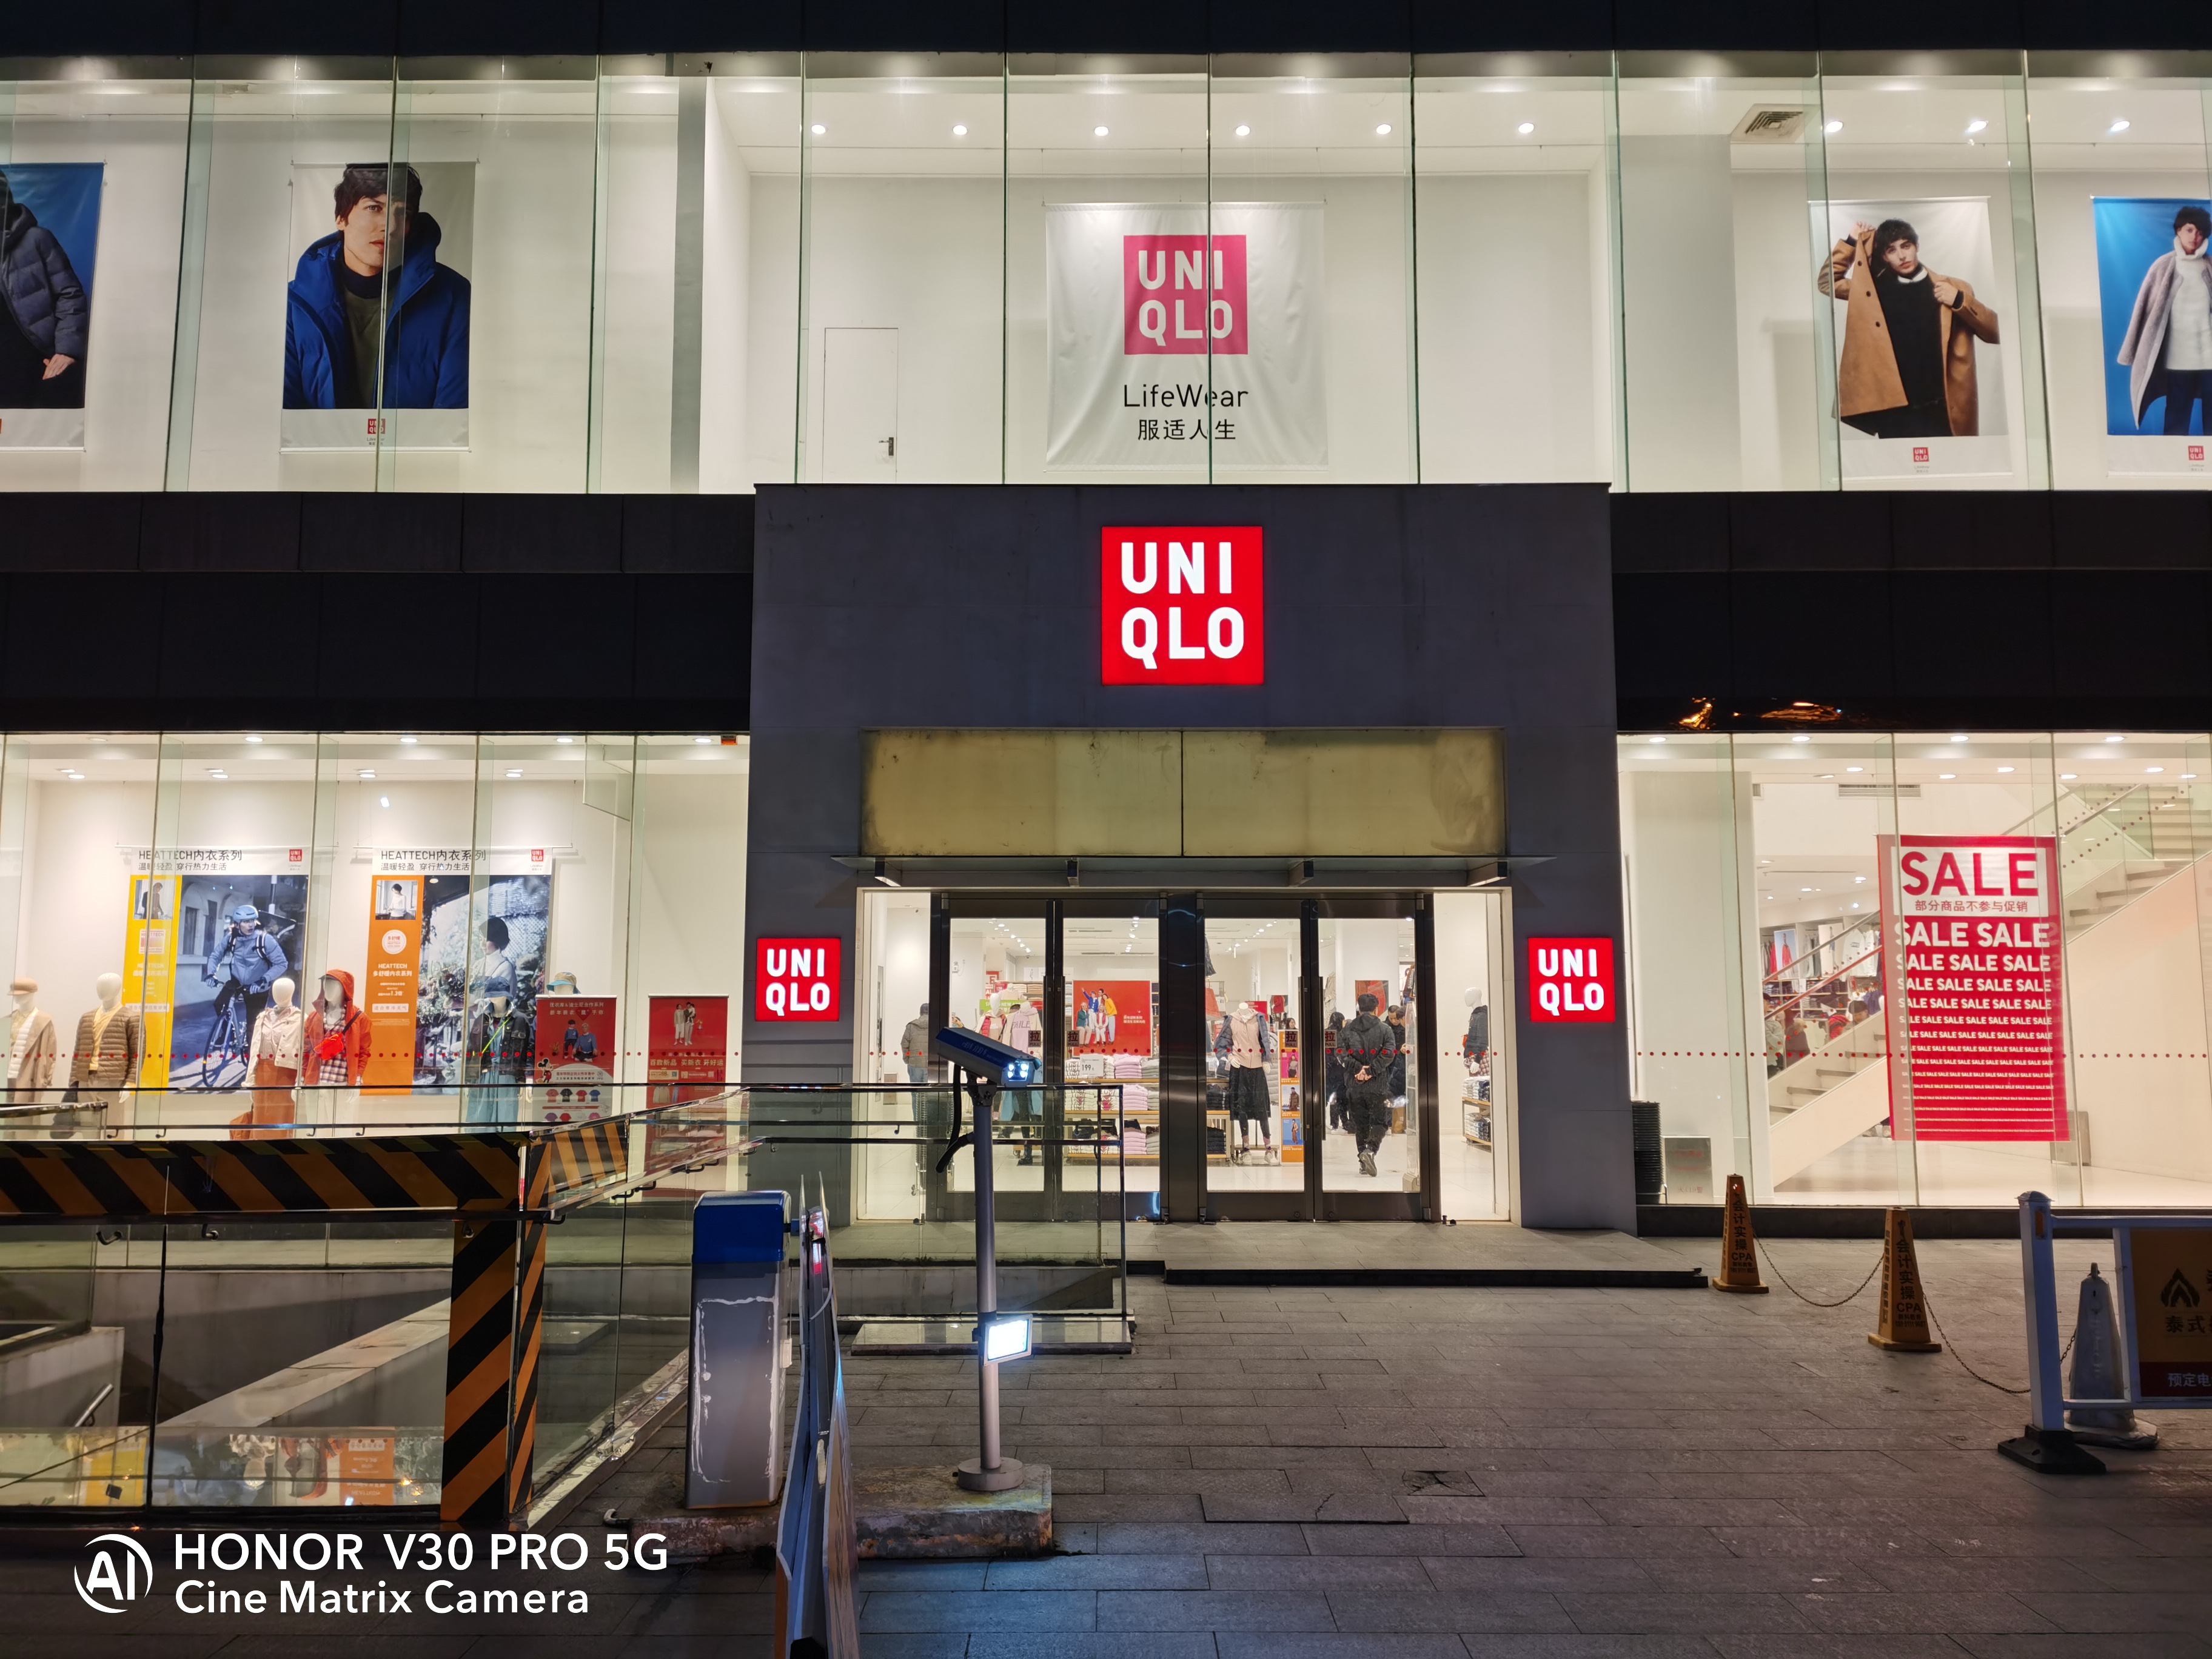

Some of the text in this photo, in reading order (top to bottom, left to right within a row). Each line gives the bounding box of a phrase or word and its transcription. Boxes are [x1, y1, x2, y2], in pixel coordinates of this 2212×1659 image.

[1138, 250, 1224, 290] UNI
[1139, 300, 1233, 346] QLO
[1124, 384, 1248, 407] LifeWear
[1138, 419, 1236, 441] 服适人生
[1121, 541, 1232, 594] UNI
[1121, 606, 1244, 669] QLO
[1901, 851, 2039, 897] SALE
[1915, 899, 2028, 913] 部分商品不参与促销
[1895, 922, 2050, 947] SALE SALE
[766, 948, 825, 977] UNI
[1538, 948, 1598, 977] UNI
[1896, 954, 2051, 972] SALE SALE SALE
[1897, 978, 2051, 992] SALE SALE SALE SALE
[766, 982, 830, 1016] QLO
[1539, 982, 1604, 1016] QLO
[1929, 998, 1959, 1009] SALE
[1961, 999, 1990, 1009] SALE
[1992, 999, 2022, 1010] SALE
[2025, 999, 2052, 1010] SALE
[1030, 1031, 1041, 1042] 拉
[1068, 1031, 1078, 1042] 拉
[1285, 1031, 1297, 1042] 拉
[1325, 1031, 1335, 1042] 拉
[1732, 1252, 1753, 1261] CPA
[1896, 1241, 1915, 1300] 会计实操
[1897, 1302, 1922, 1313] CPA
[2165, 1315, 2212, 1334] 泰式
[2167, 1372, 2212, 1387] 预定电
